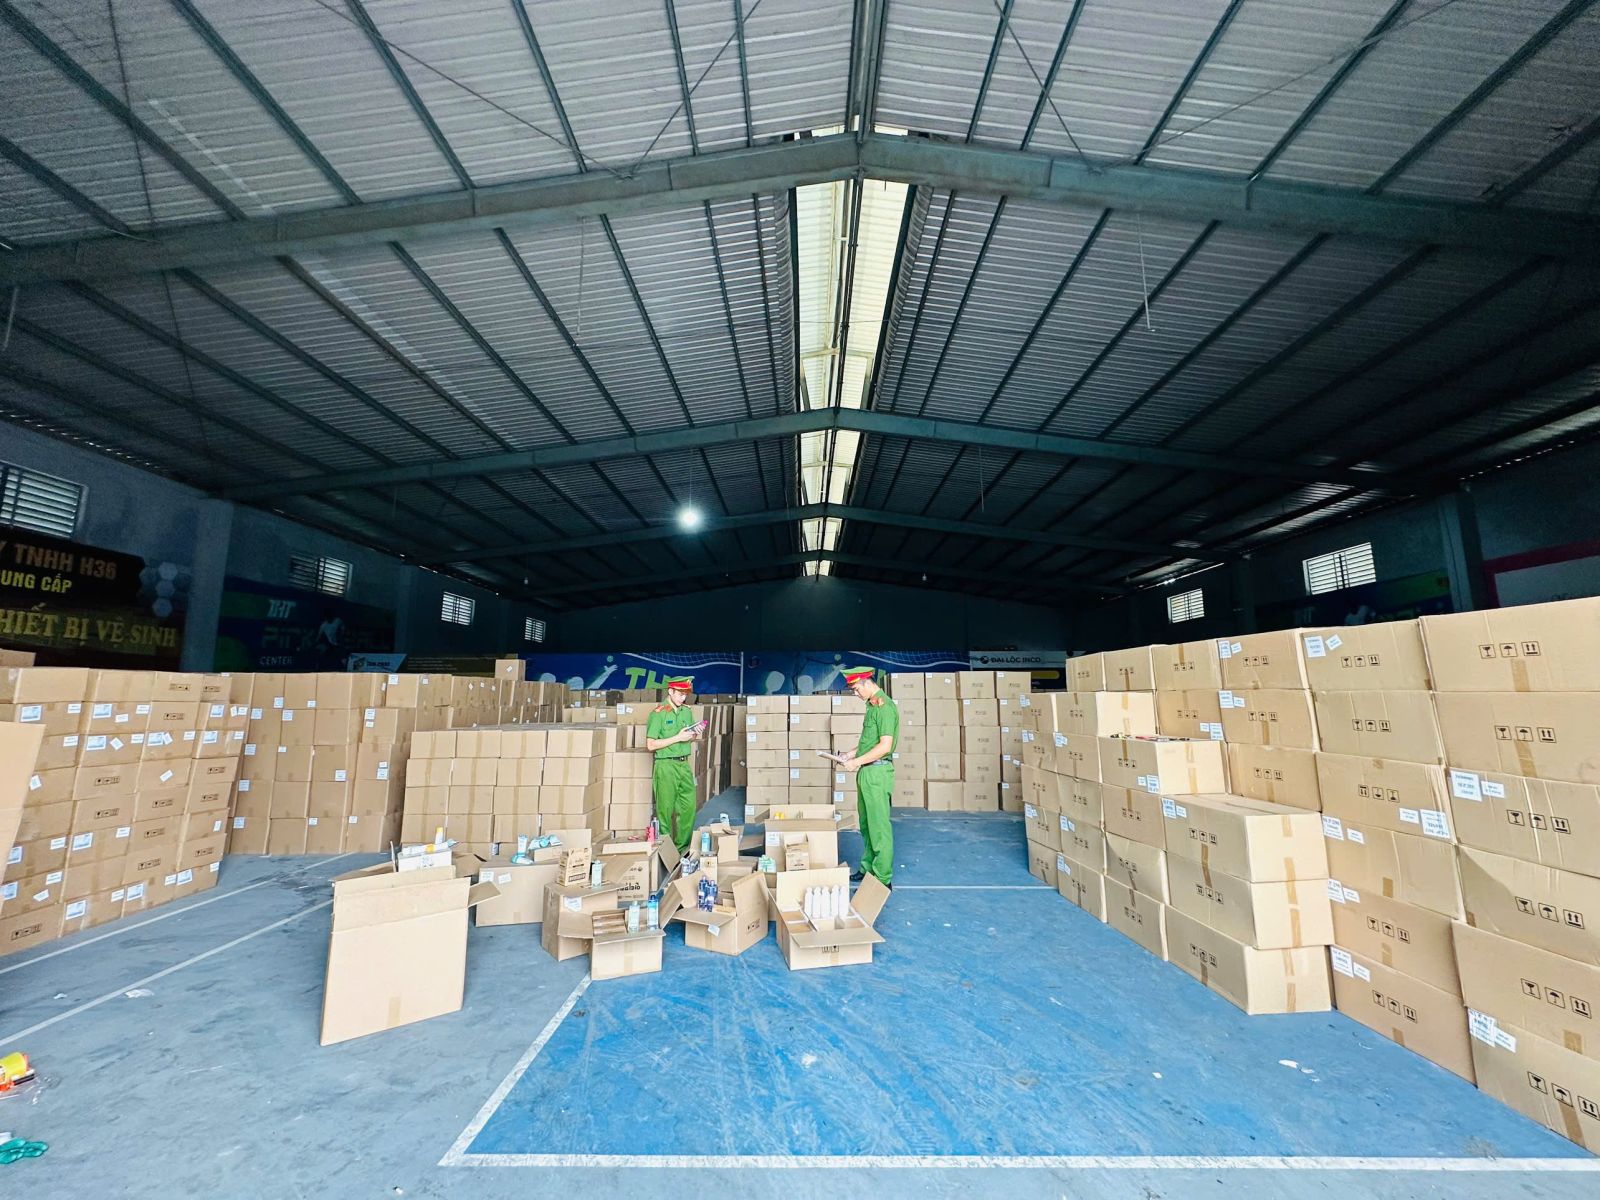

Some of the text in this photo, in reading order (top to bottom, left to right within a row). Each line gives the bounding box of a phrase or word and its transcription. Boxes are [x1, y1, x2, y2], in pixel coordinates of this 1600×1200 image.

[14, 543, 74, 573] TNHH
[79, 556, 118, 581] H36
[0, 569, 73, 594] UNG CẤP
[63, 616, 90, 646] BỊ
[96, 615, 125, 648] VỆ
[129, 624, 177, 648] SINH
